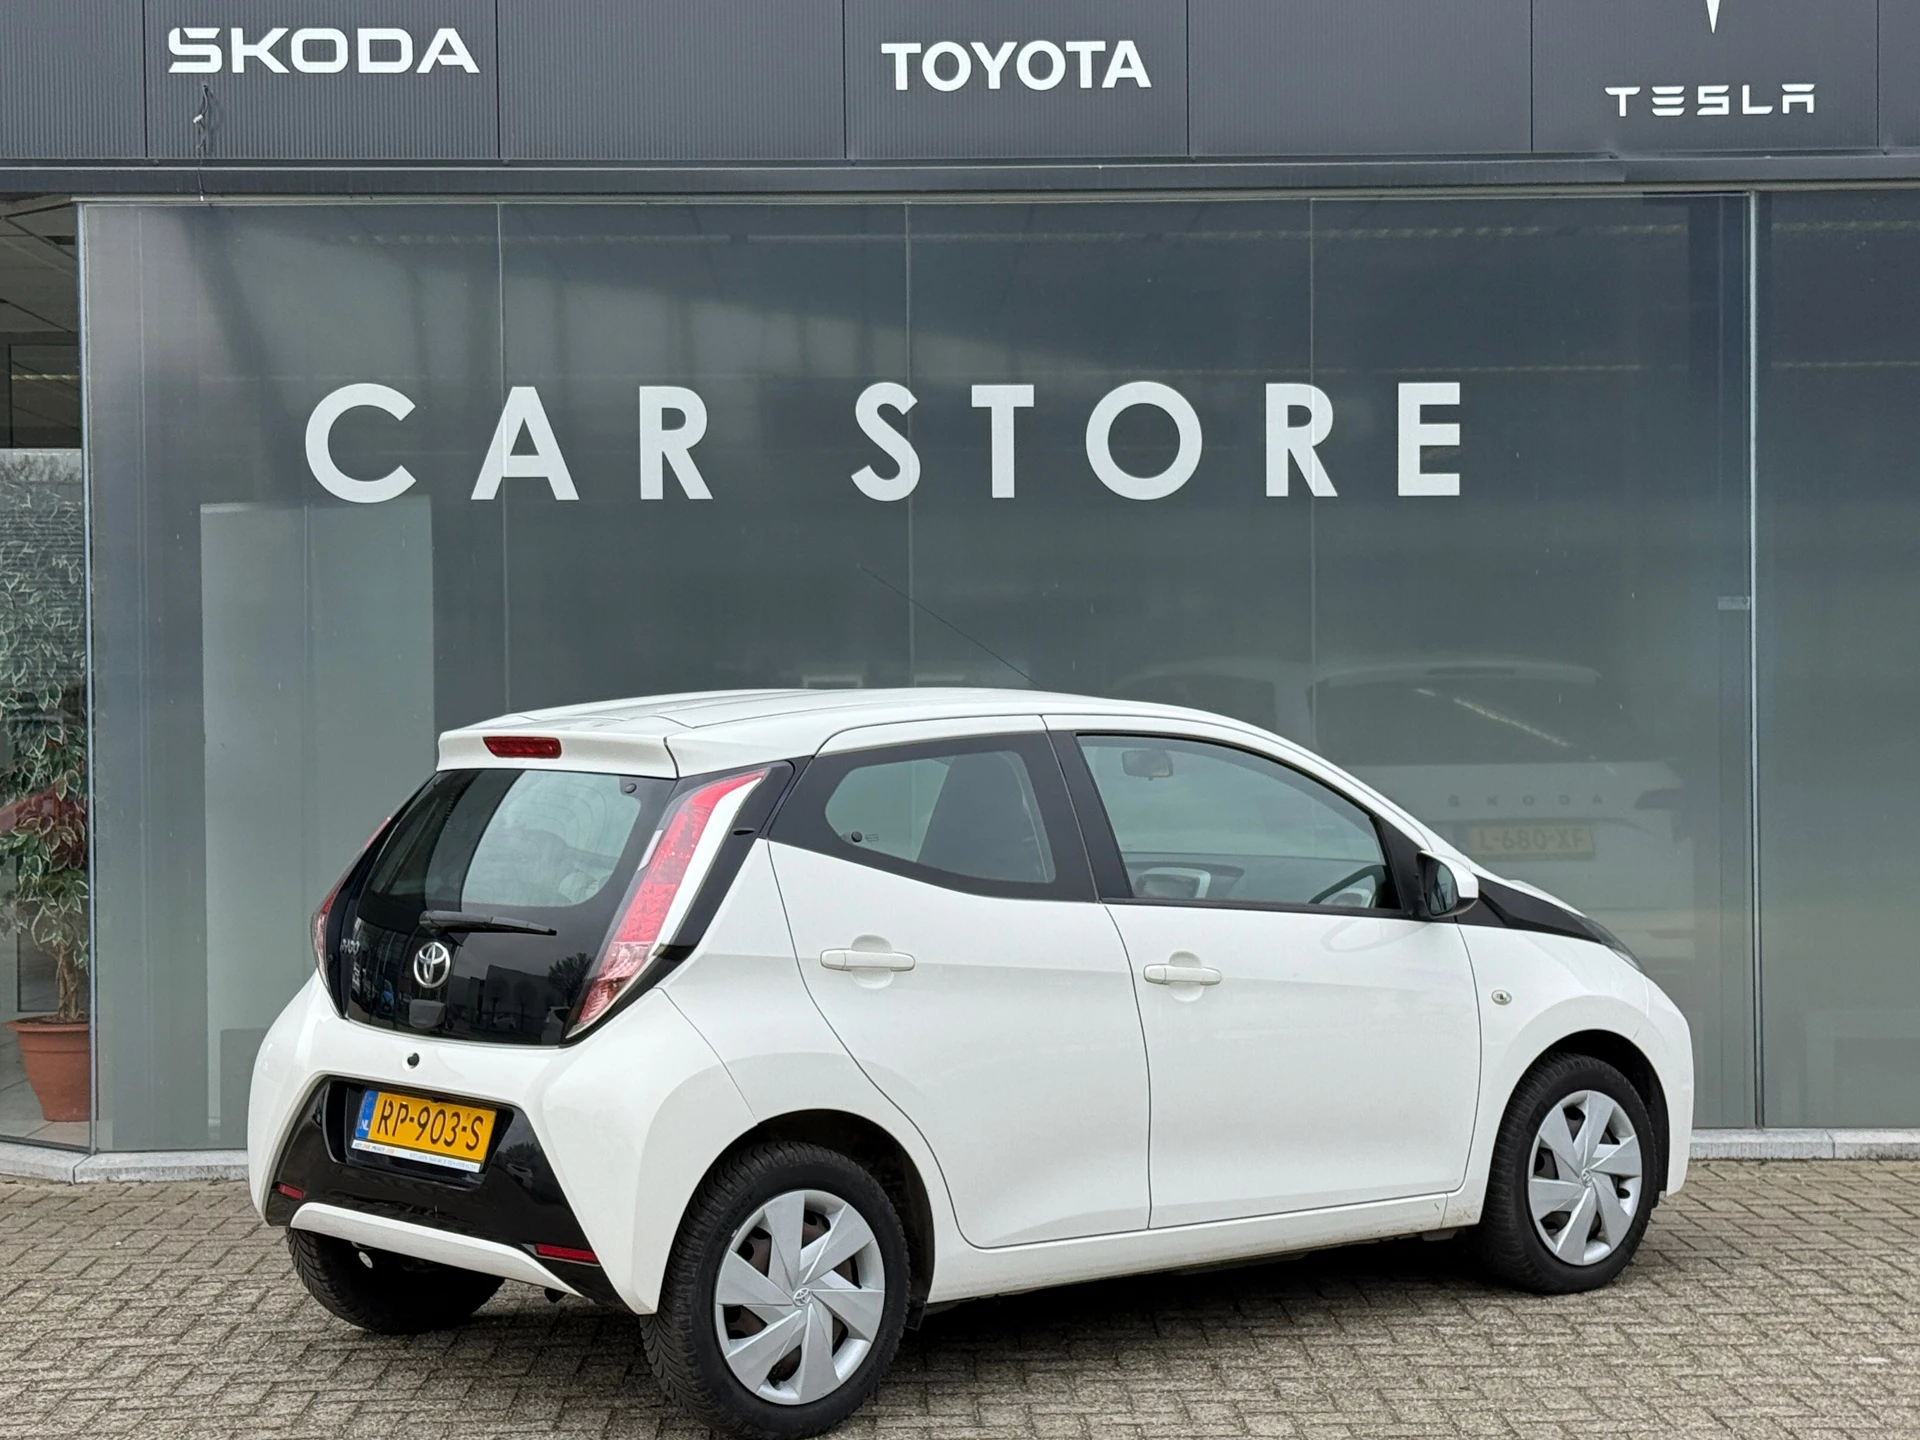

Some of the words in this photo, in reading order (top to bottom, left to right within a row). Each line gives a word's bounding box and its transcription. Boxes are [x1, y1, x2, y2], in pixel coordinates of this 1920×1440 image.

[881, 41, 1151, 91] TOYOTA
[1605, 84, 1814, 116] TESLA
[306, 383, 712, 502] CAR
[852, 382, 1459, 501] STORE
[359, 1119, 369, 1131] NL
[376, 1099, 484, 1151] RP-903-S
